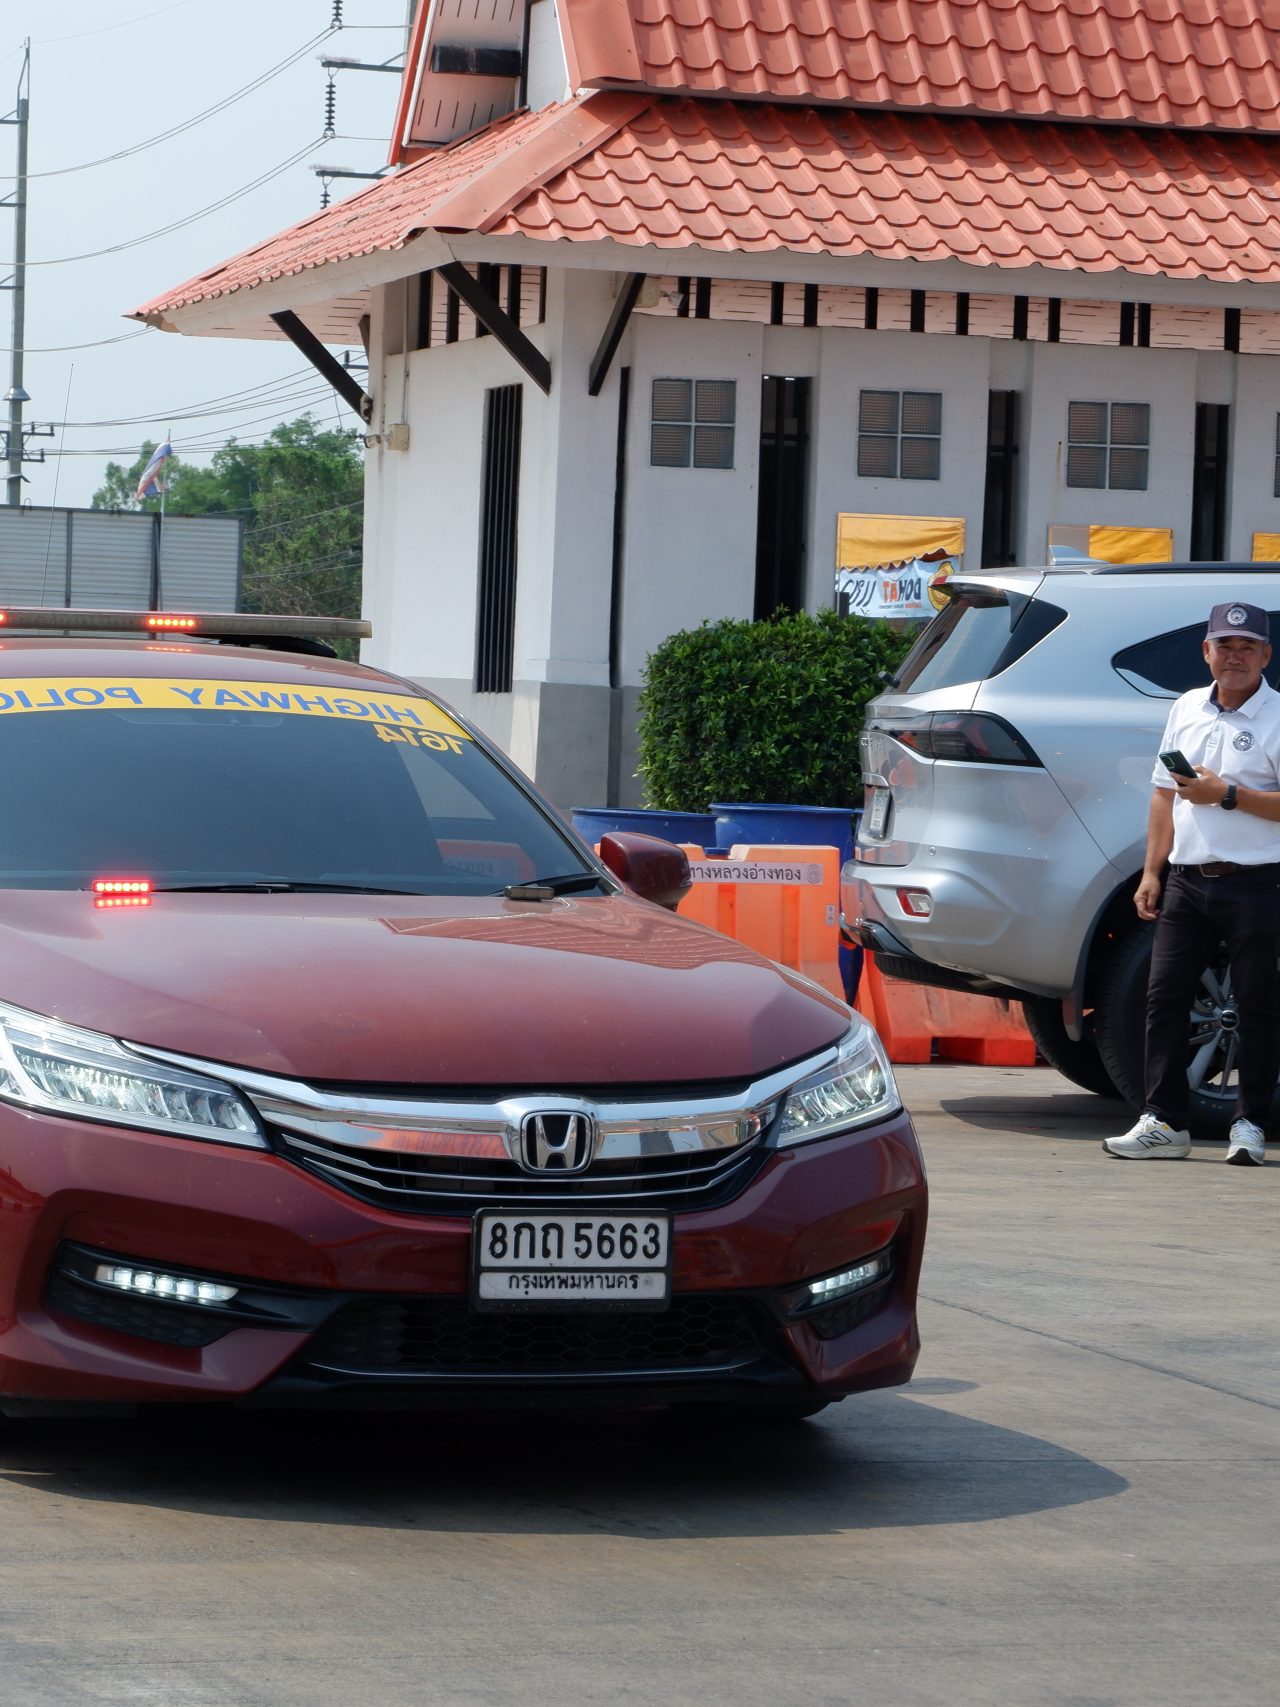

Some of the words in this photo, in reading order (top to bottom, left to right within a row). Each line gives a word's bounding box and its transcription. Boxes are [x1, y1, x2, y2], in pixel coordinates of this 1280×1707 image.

[574, 1222, 661, 1260] 5663
[508, 1273, 640, 1296] กรุงเทพมหานคร
